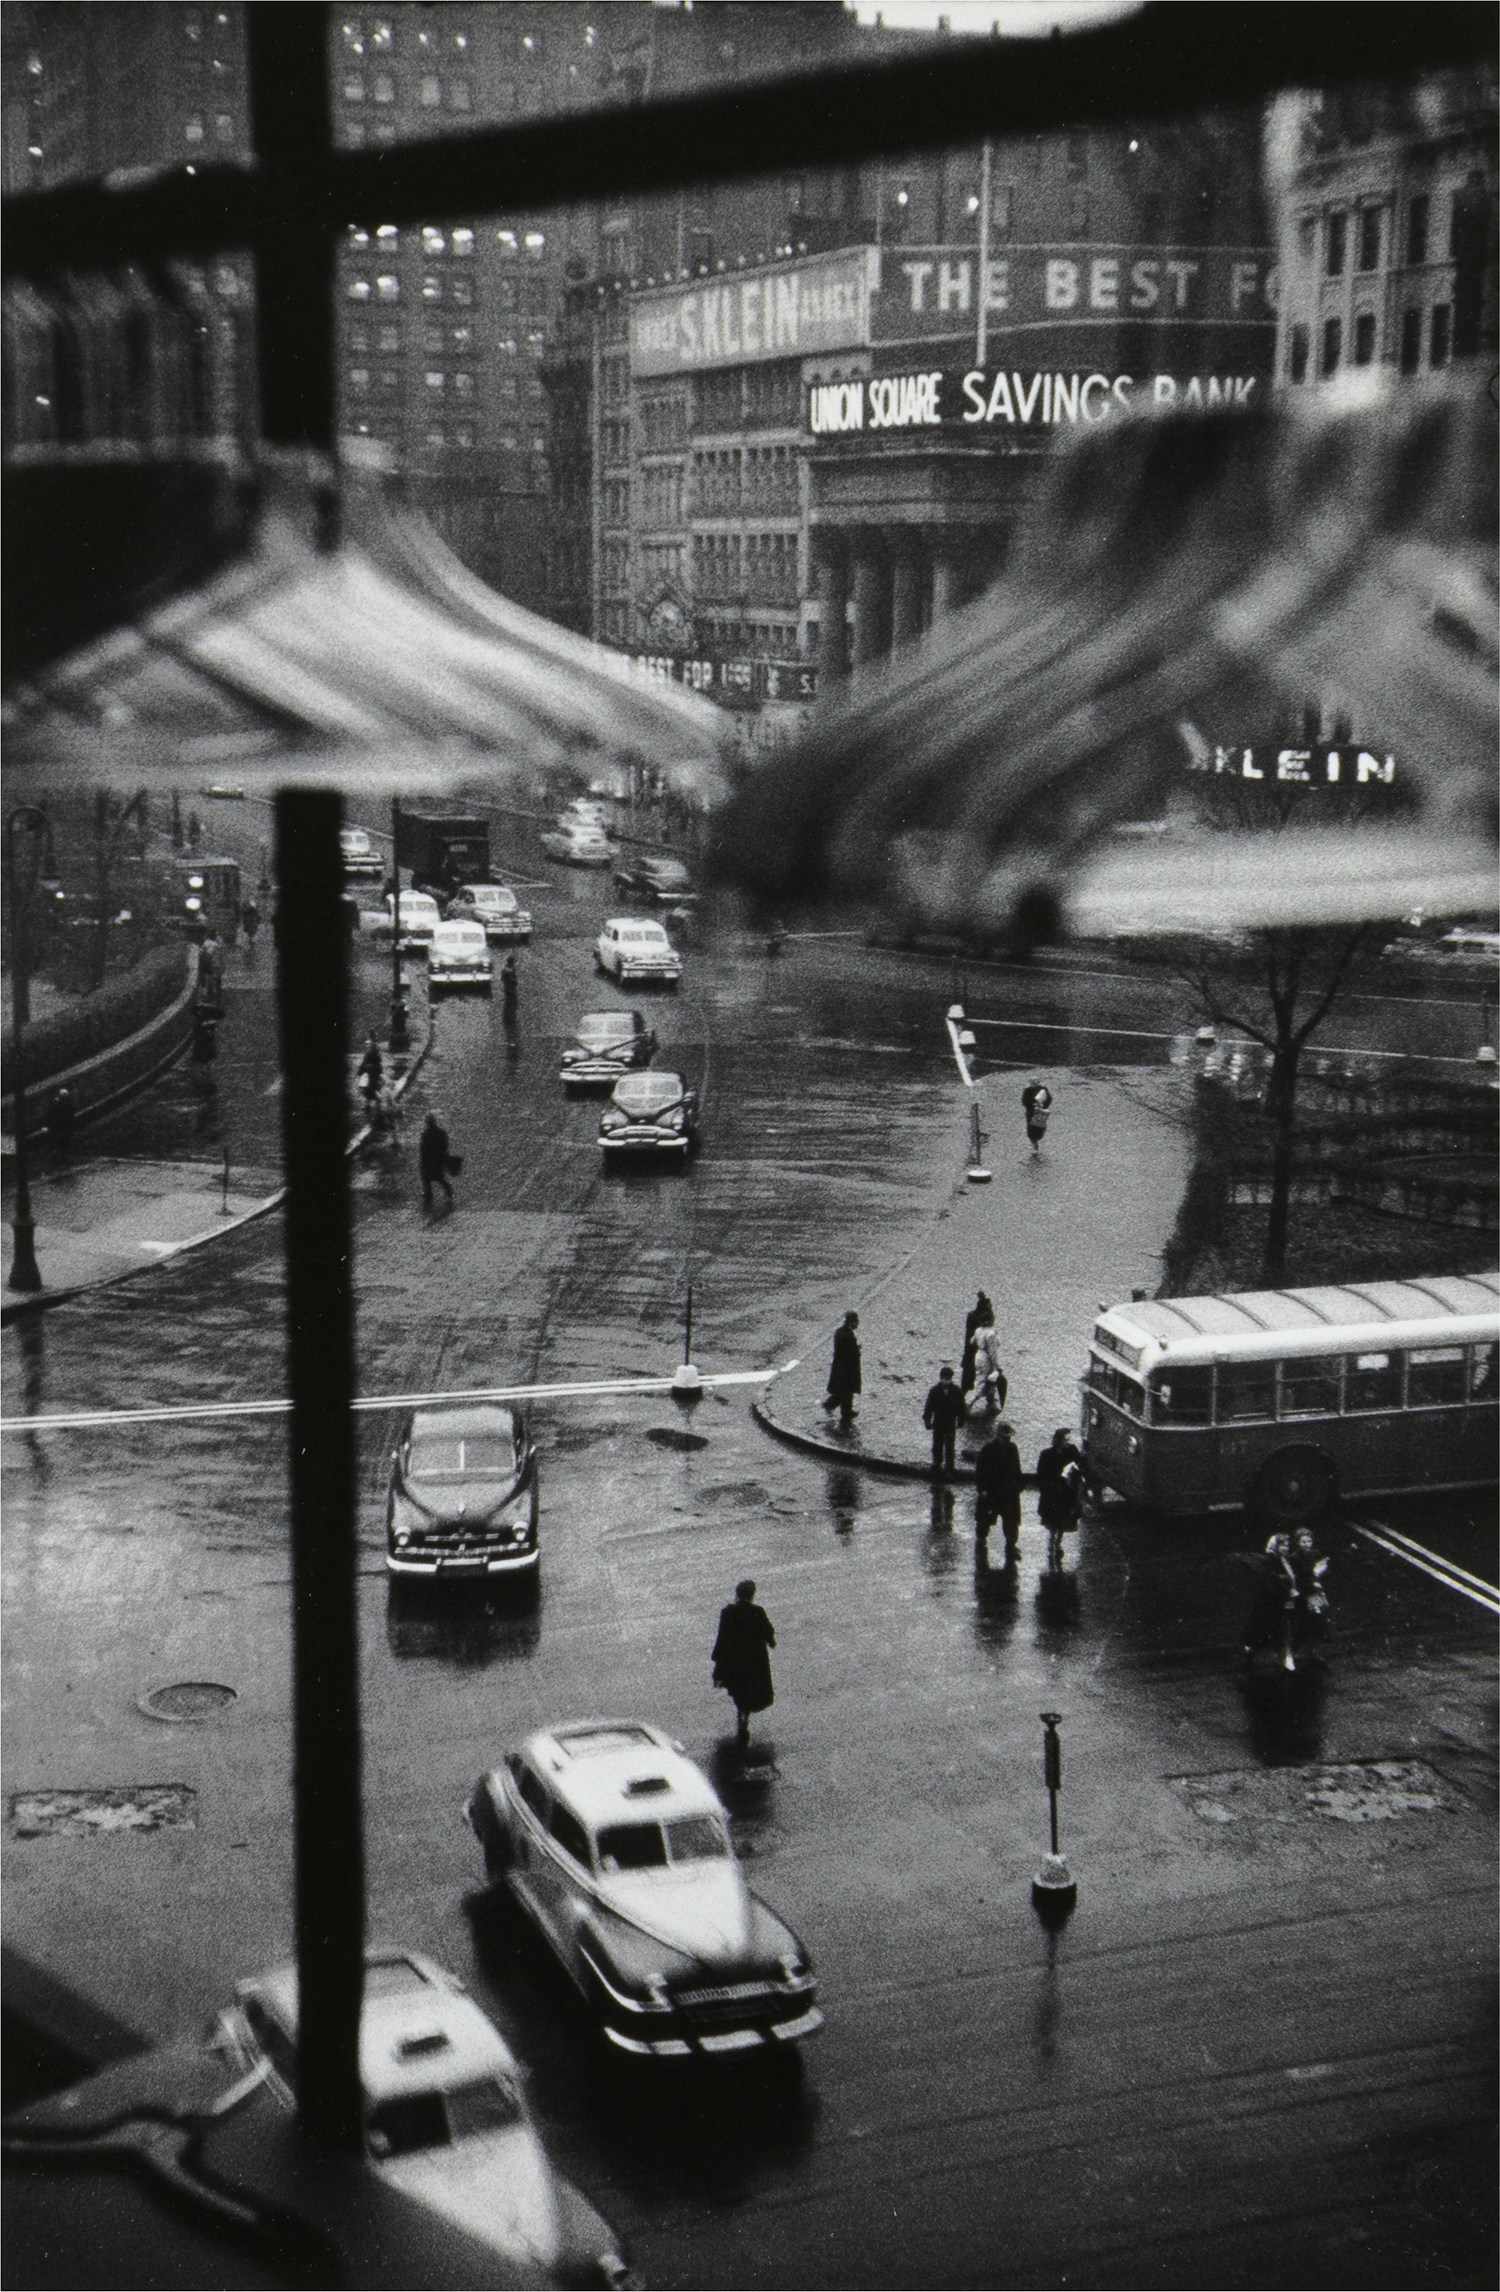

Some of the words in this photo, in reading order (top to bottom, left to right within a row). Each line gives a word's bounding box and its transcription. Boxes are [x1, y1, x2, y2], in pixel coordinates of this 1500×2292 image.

[904, 259, 1008, 313] THE
[1045, 258, 1198, 309] BEST
[811, 381, 864, 433] UNION
[869, 371, 943, 429] SQUARE
[962, 372, 1133, 423] SAVINGS
[1214, 745, 1395, 784] KLEIN
